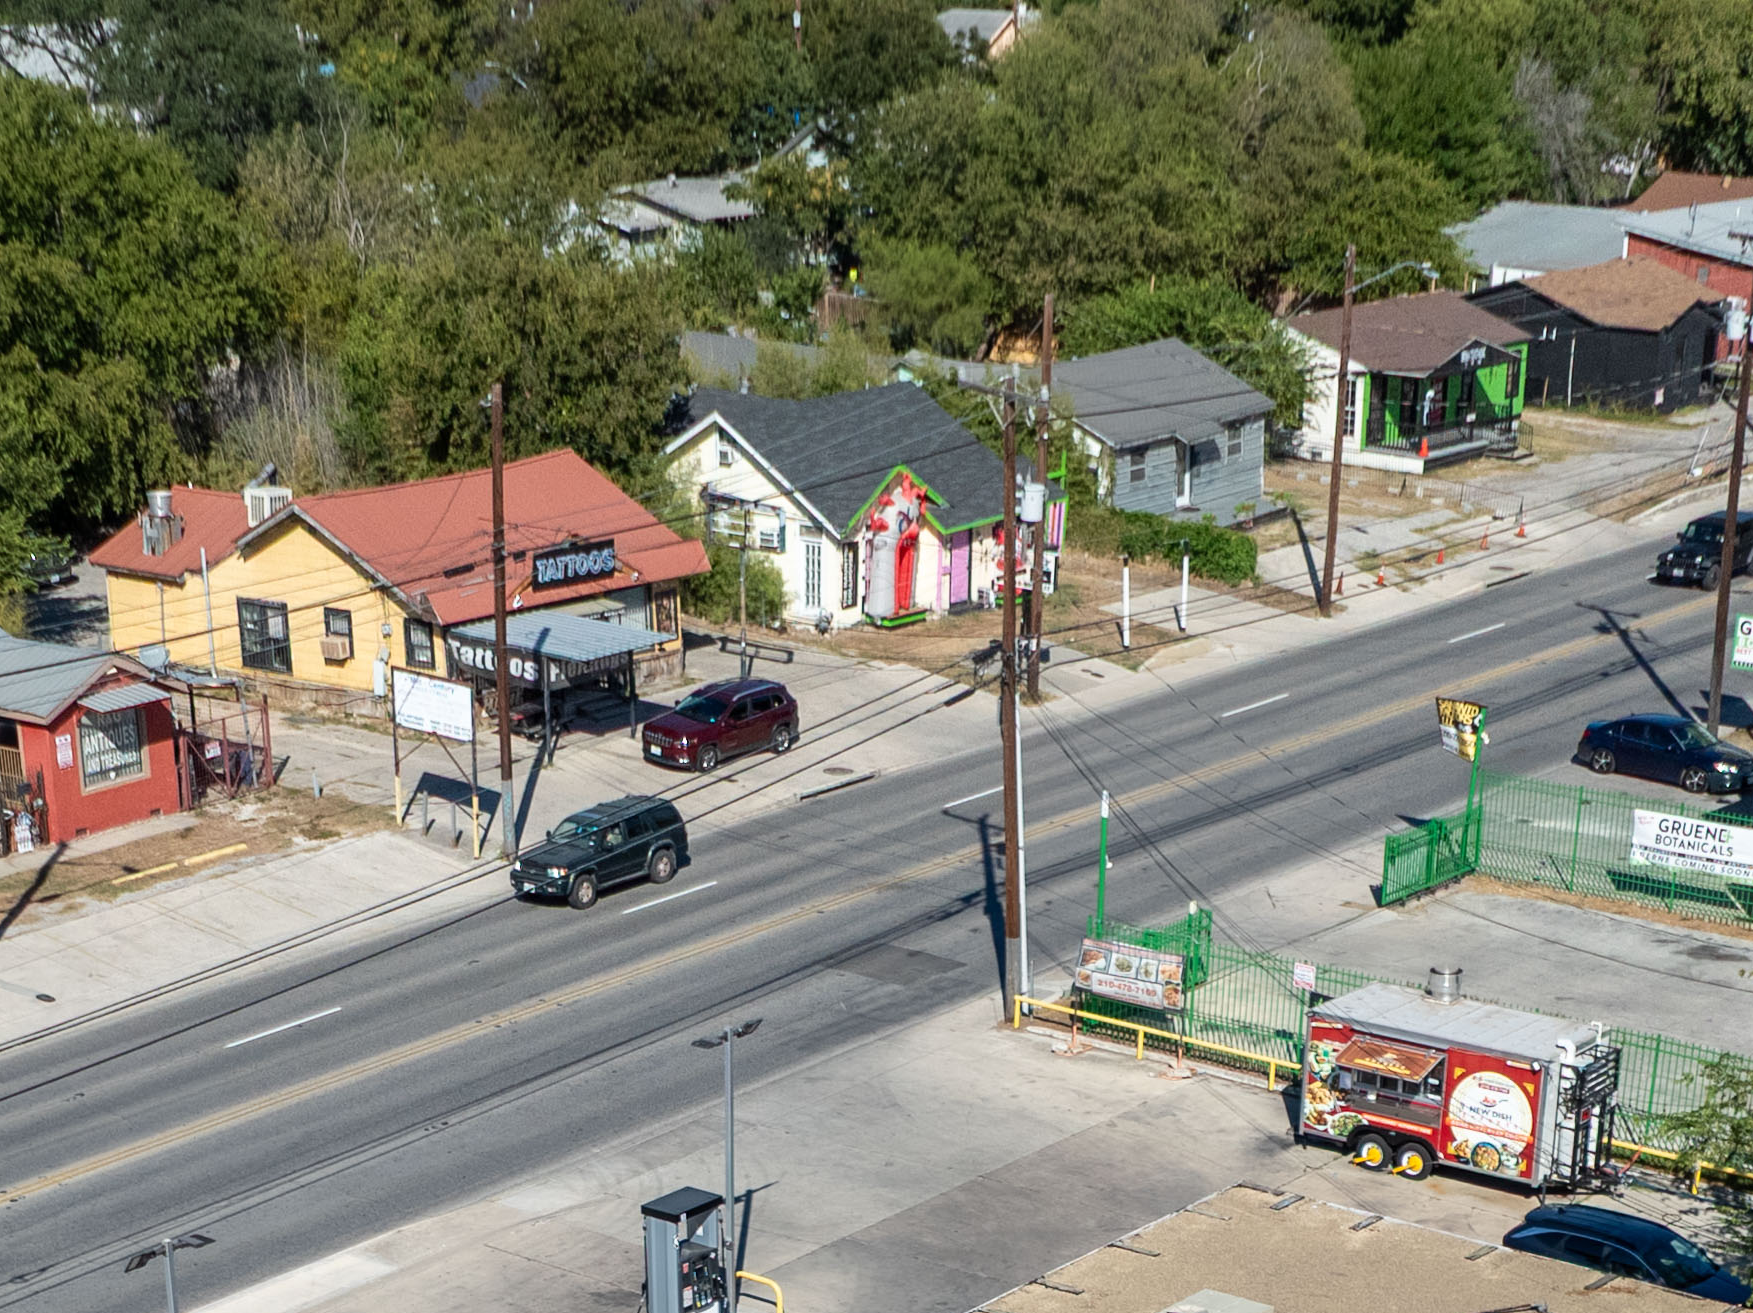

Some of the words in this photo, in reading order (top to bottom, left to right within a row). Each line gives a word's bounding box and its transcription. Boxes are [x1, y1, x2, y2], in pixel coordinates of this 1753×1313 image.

[536, 548, 615, 583] TATTOOS
[448, 638, 540, 682] Tattos
[84, 724, 137, 755] ANTIQUES
[1658, 818, 1729, 844] GRUENE
[1654, 833, 1734, 857] BOTANICALS
[1675, 858, 1716, 873] COMING
[1469, 1105, 1491, 1116] NEW
[1492, 1110, 1512, 1121] DISH
